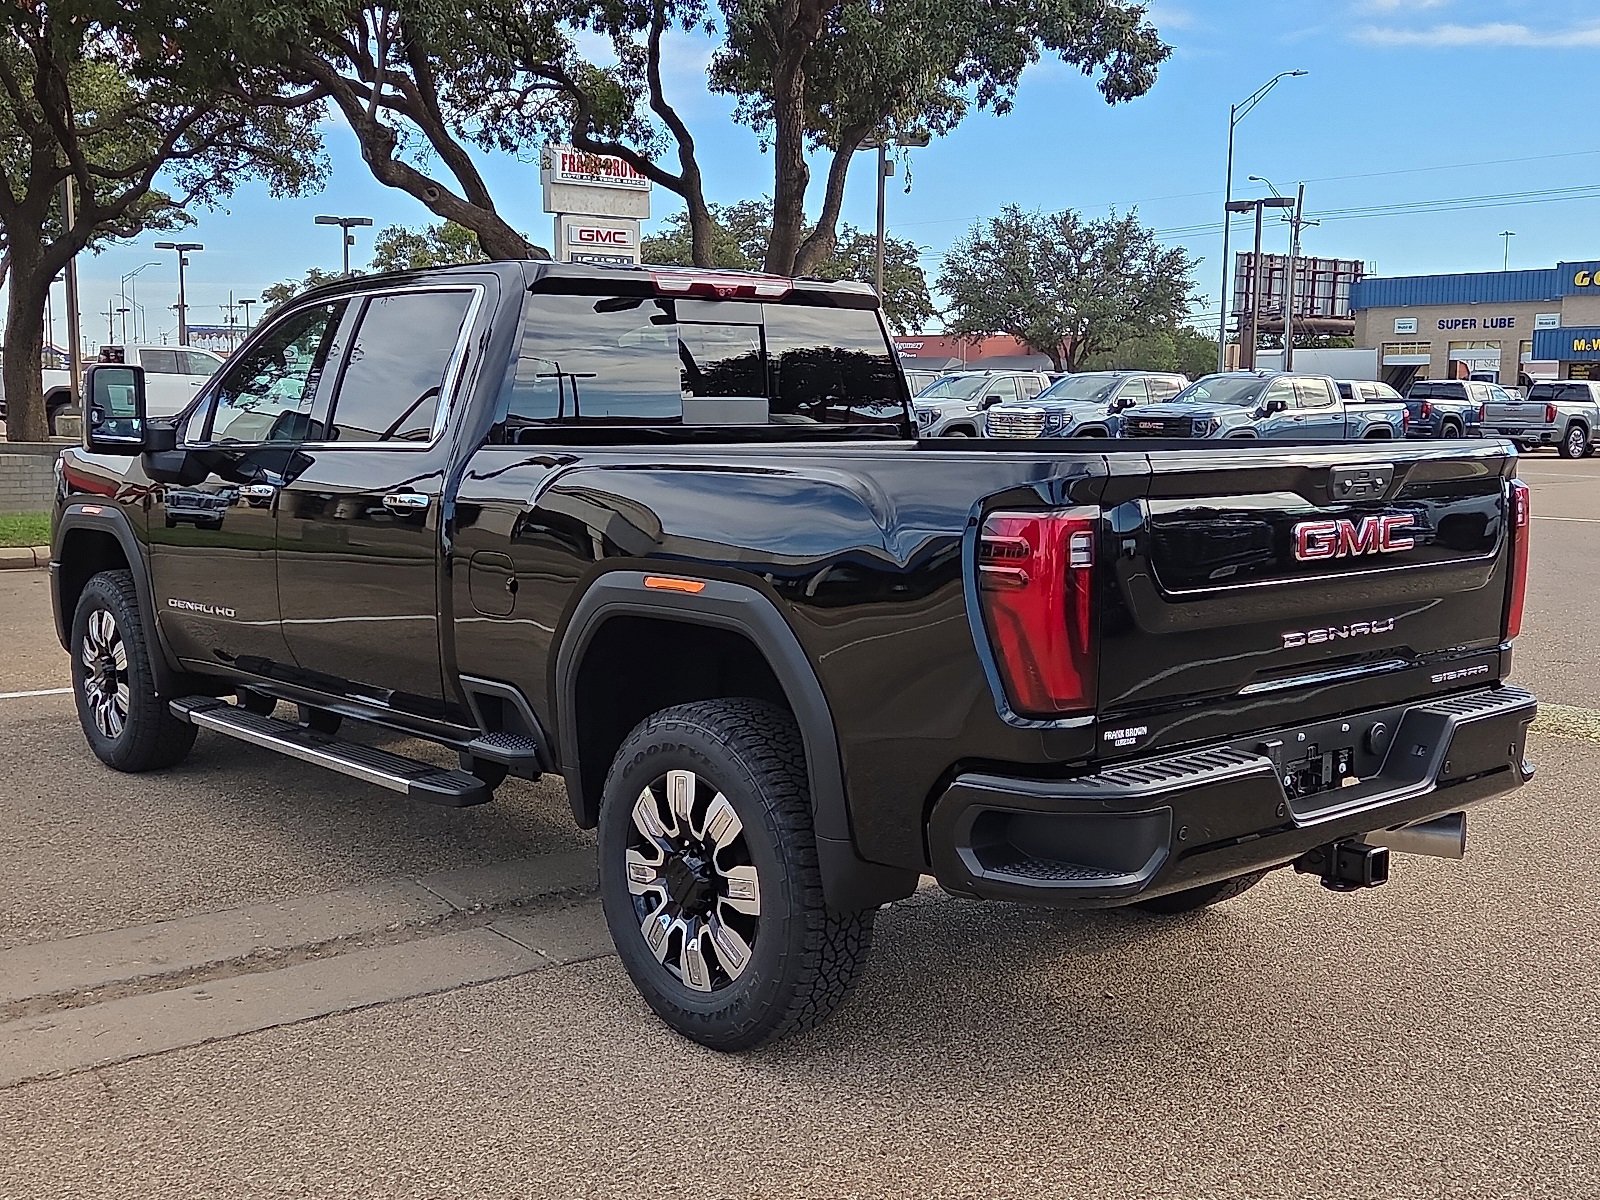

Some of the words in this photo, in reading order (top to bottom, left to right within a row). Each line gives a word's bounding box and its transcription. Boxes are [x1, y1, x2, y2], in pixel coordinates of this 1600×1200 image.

[604, 157, 646, 180] BROW
[579, 229, 628, 244] GMC
[1437, 318, 1477, 330] SUPER
[1482, 317, 1515, 329] LUBE
[1292, 514, 1415, 560] GMC
[168, 598, 214, 614] DENALI
[215, 606, 236, 617] HD
[1282, 617, 1395, 648] DENALI
[1430, 664, 1489, 683] SIERRA
[1103, 729, 1125, 740] FRANK
[1125, 726, 1147, 737] BROWN
